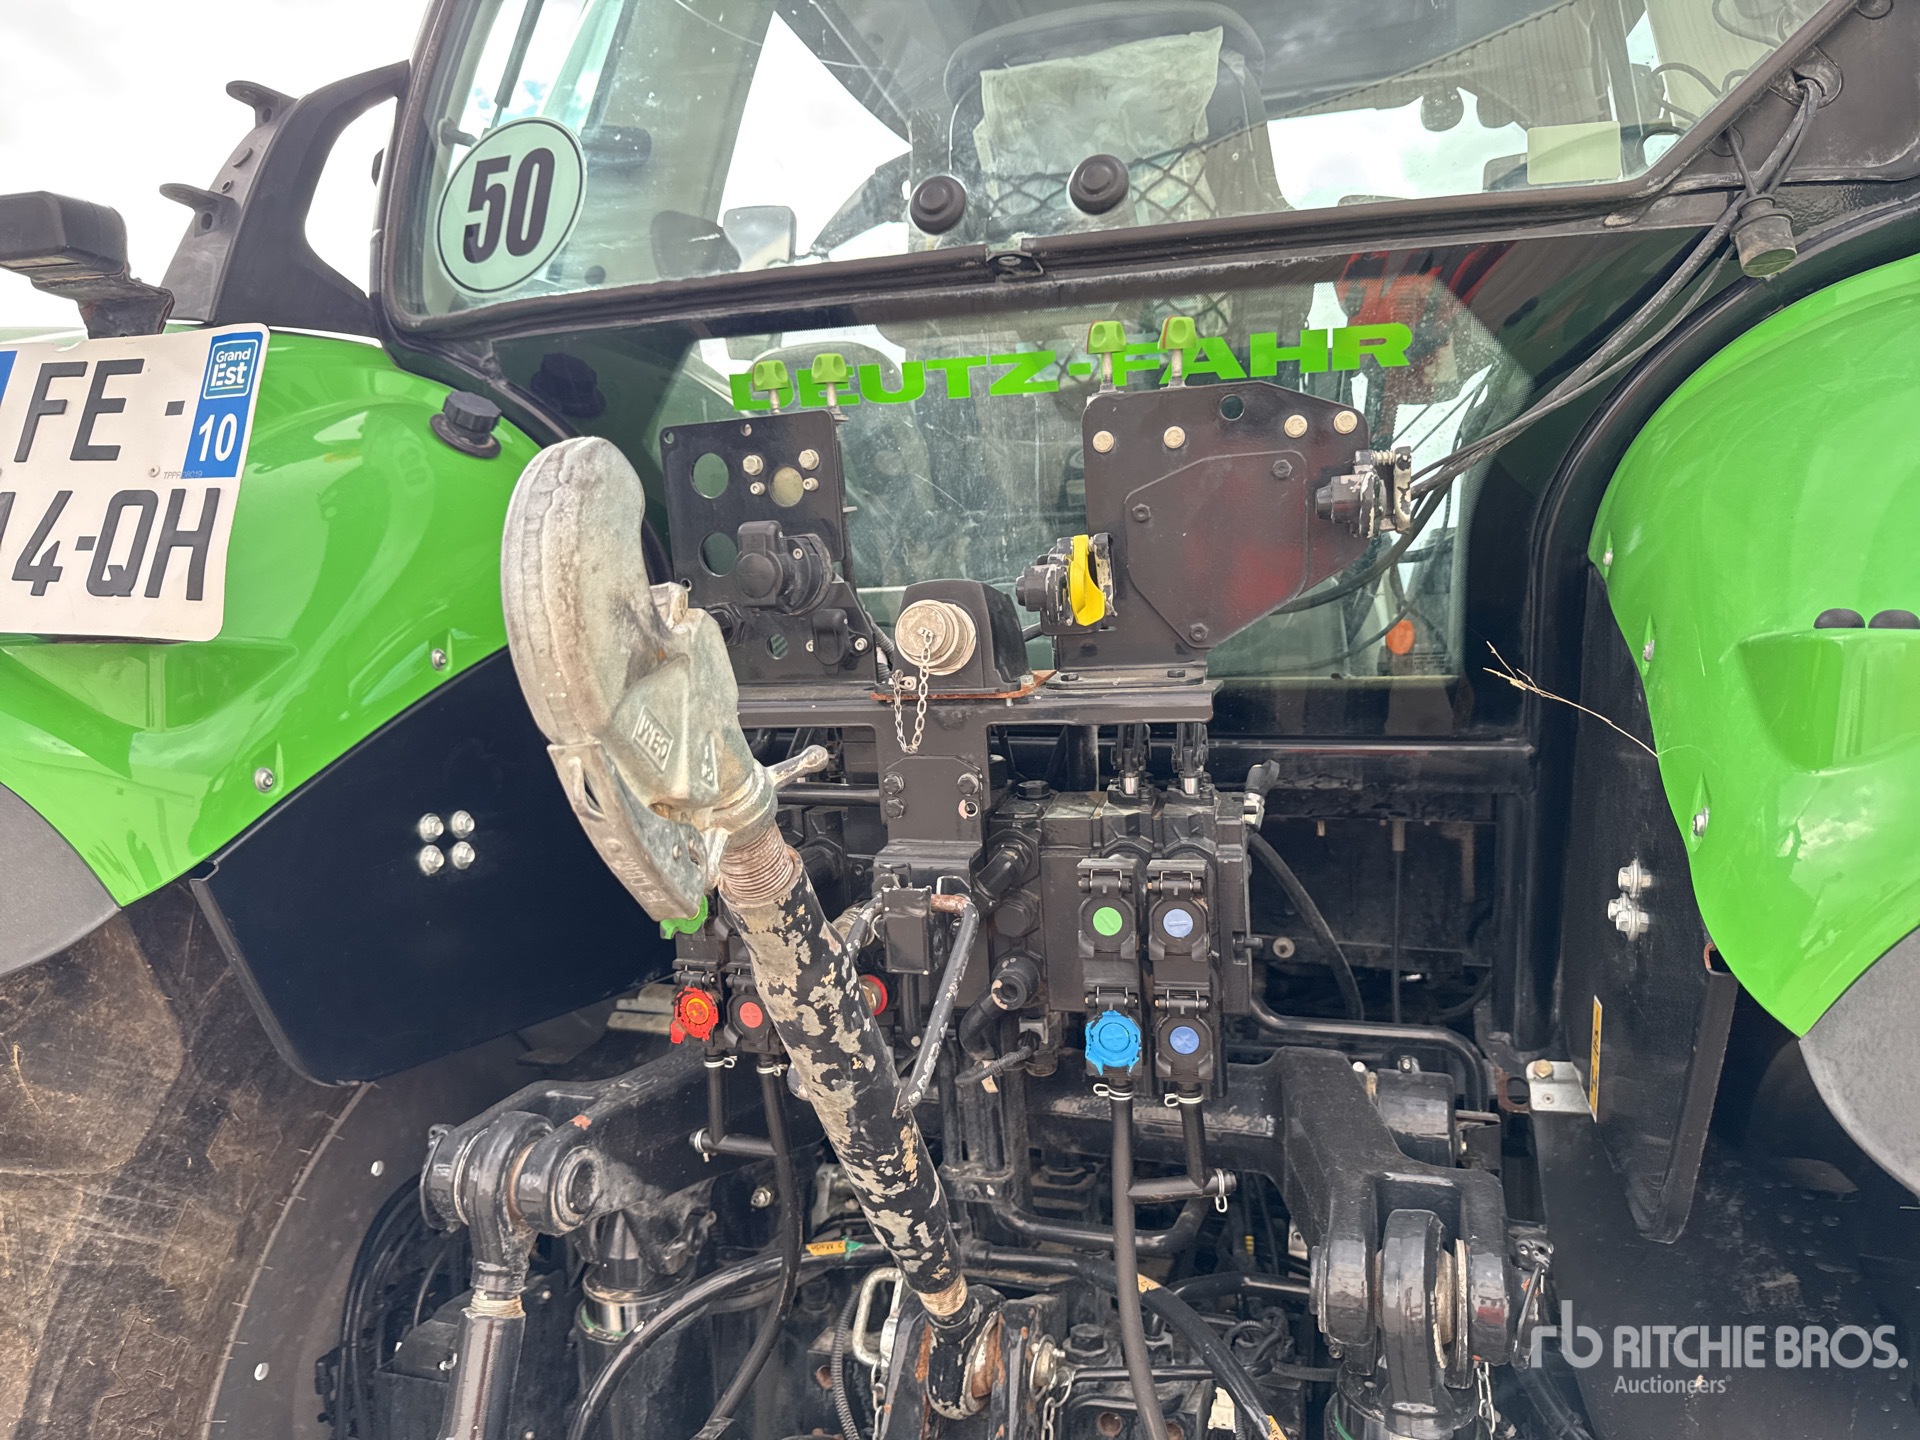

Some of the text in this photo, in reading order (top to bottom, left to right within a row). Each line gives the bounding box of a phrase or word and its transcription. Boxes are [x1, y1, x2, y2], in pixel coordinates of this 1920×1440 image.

[463, 147, 556, 264] 50
[211, 362, 247, 387] Est
[216, 347, 251, 363] Grand
[729, 322, 1413, 412] DEUTZ-FAHR
[198, 413, 238, 462] 10
